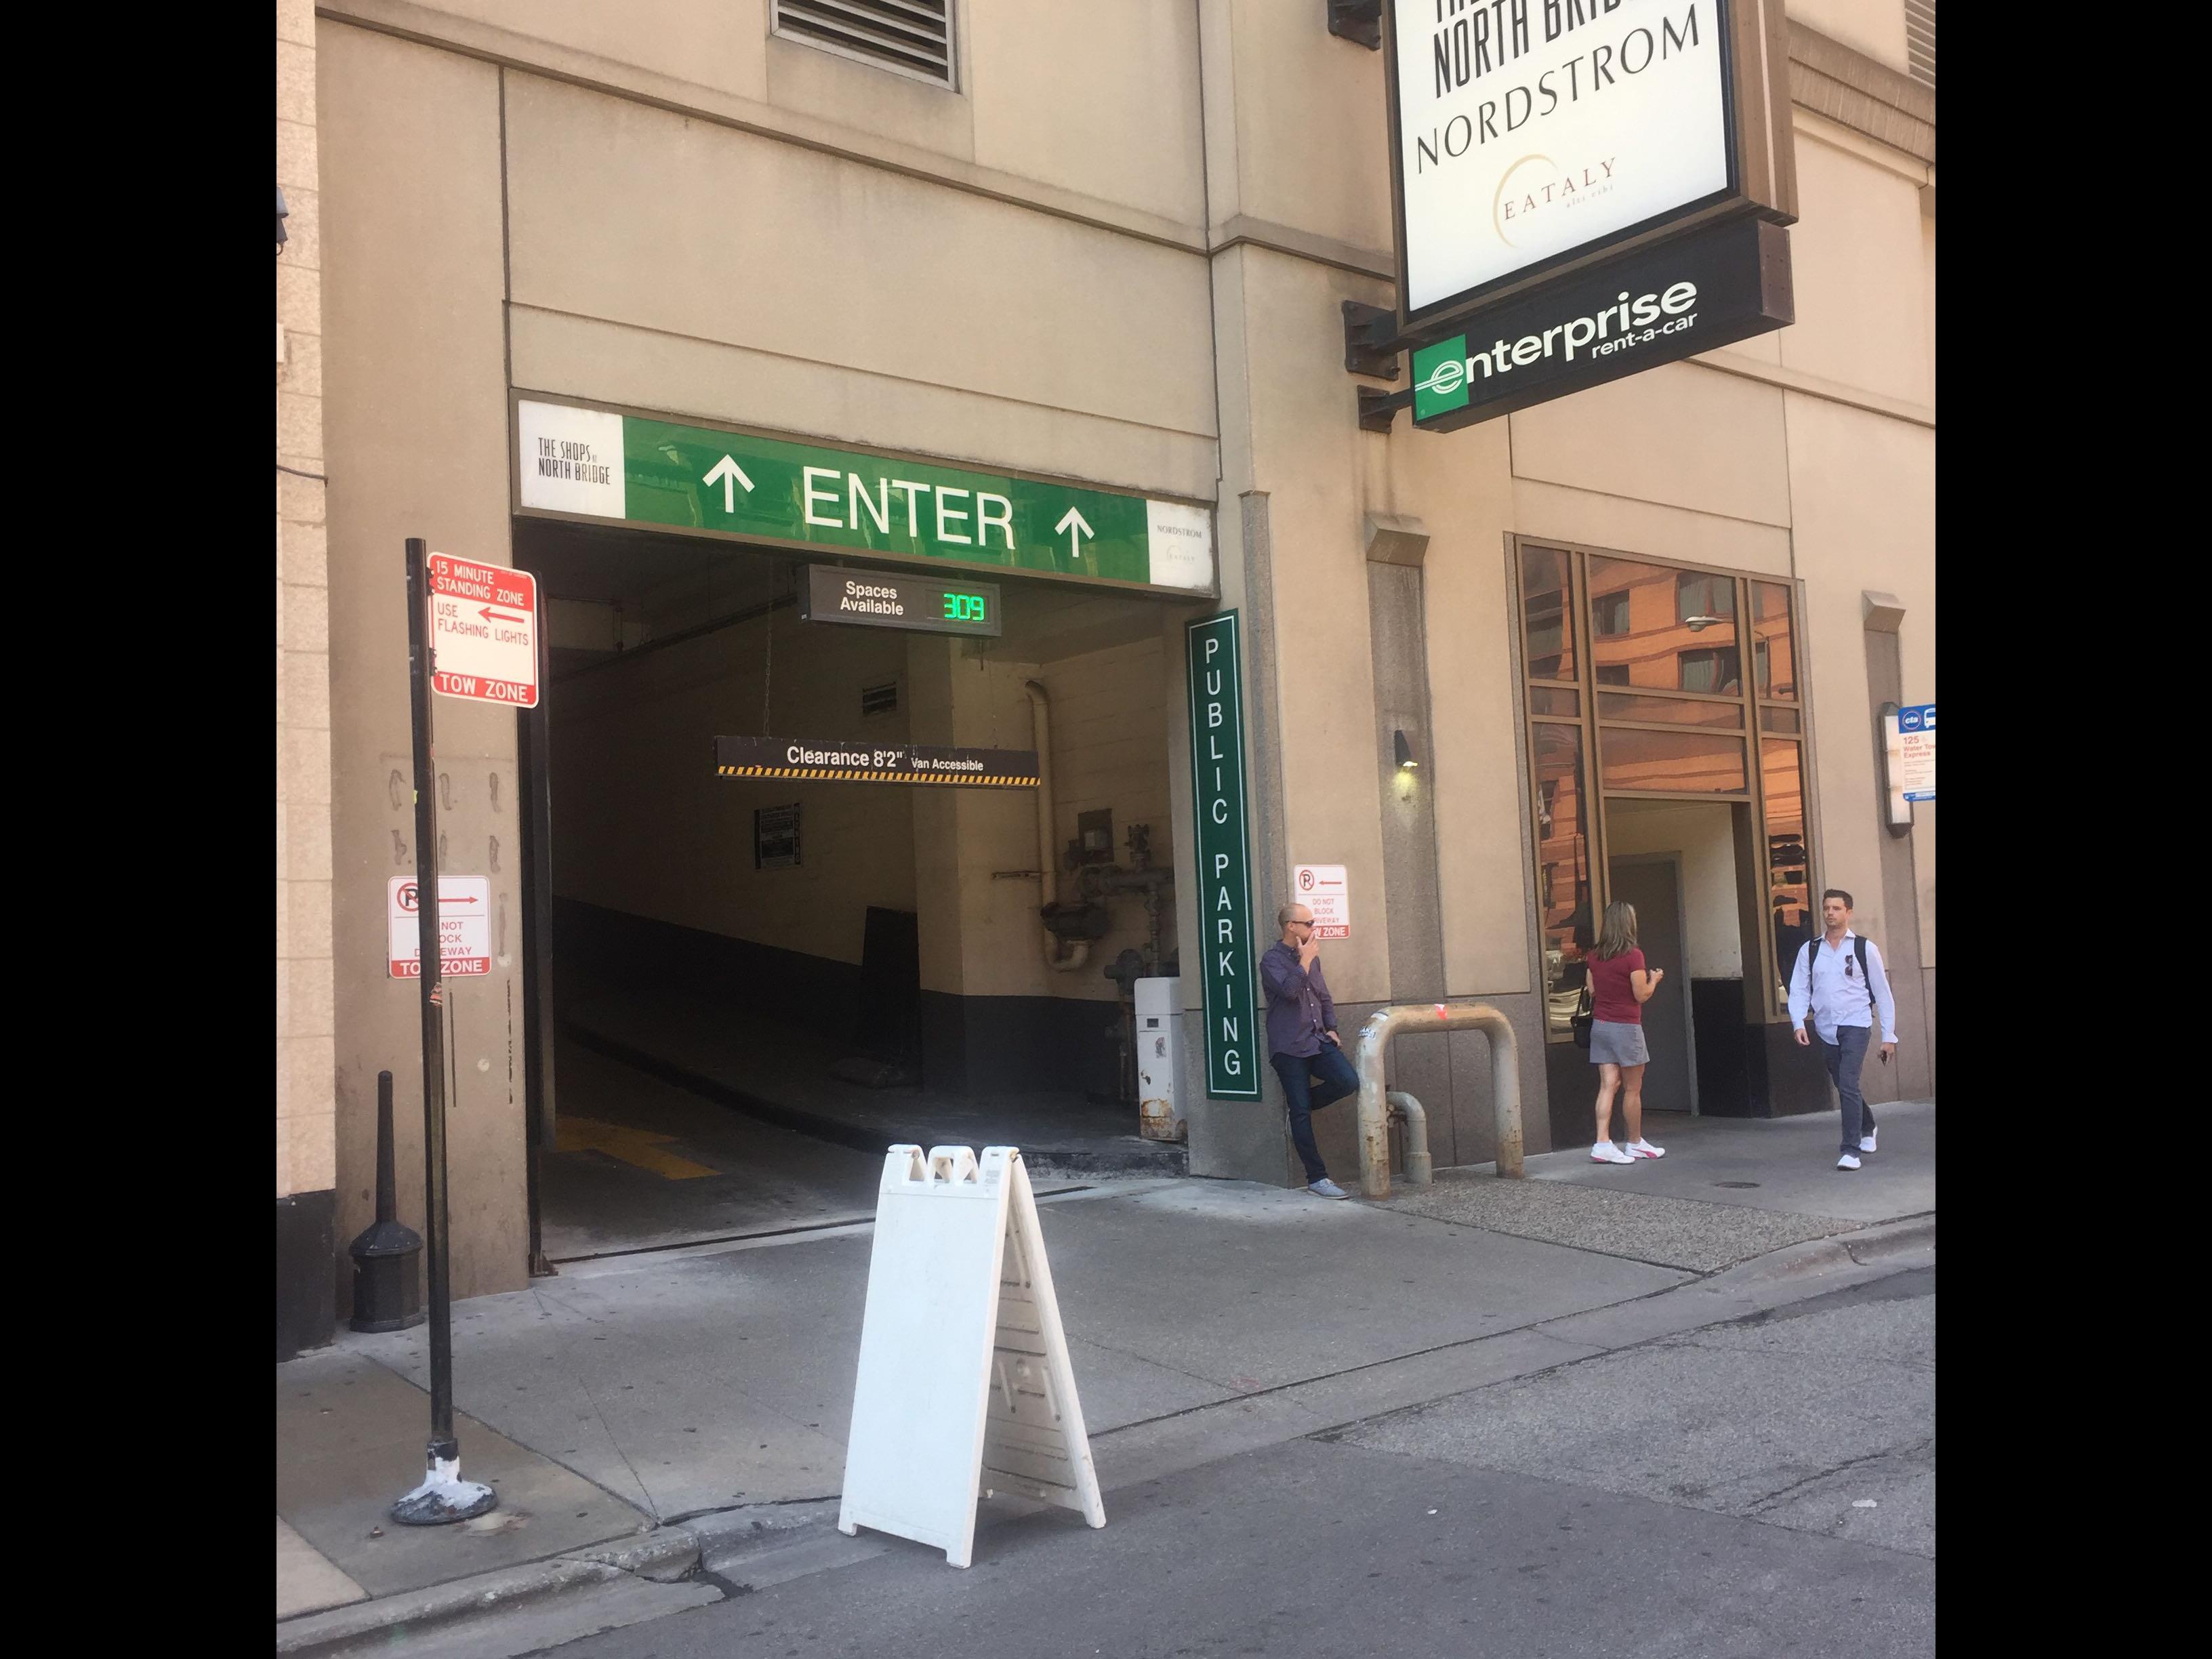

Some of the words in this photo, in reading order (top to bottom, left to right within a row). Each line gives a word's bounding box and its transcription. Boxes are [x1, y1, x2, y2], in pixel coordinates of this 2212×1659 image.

[1433, 0, 1530, 99] NORTH
[1416, 4, 1700, 174] NORDSTROM
[1504, 157, 1616, 221] EATALY
[1414, 281, 1698, 395] enterprise
[1591, 310, 1698, 360] rent-a-car
[538, 437, 556, 458] THE
[560, 441, 591, 462] SHOPS
[538, 457, 571, 480] NORTH
[575, 462, 611, 485] BRIDGE
[803, 466, 1016, 550] ENTER
[1157, 525, 1202, 539] NORDSTROM
[436, 560, 449, 575] 15
[454, 564, 494, 585] MINUTE
[436, 576, 491, 600] STANDING
[496, 588, 525, 607] ZONE
[845, 580, 898, 600] Spaces
[438, 602, 458, 617] USE
[840, 597, 904, 616] Available
[943, 593, 985, 622] 309
[438, 618, 489, 638] FLASHING
[495, 629, 529, 646] LIGHTS
[440, 674, 476, 695] TOW
[485, 680, 529, 703] ZONE
[1205, 638, 1228, 825] PUBLIC
[1904, 736, 1919, 744] 125
[787, 745, 869, 767] Clearance
[873, 750, 903, 769] 8'2"
[911, 757, 930, 770] Van
[932, 758, 984, 772] Accessible
[1904, 750, 1931, 759] Express
[439, 934, 462, 943] OCK
[441, 922, 464, 930] NOT
[1323, 927, 1346, 937] ZONE
[415, 947, 472, 957] DEWAY
[1214, 853, 1242, 1076] PARKING
[400, 962, 420, 975] TO
[441, 960, 483, 974] ZONE
